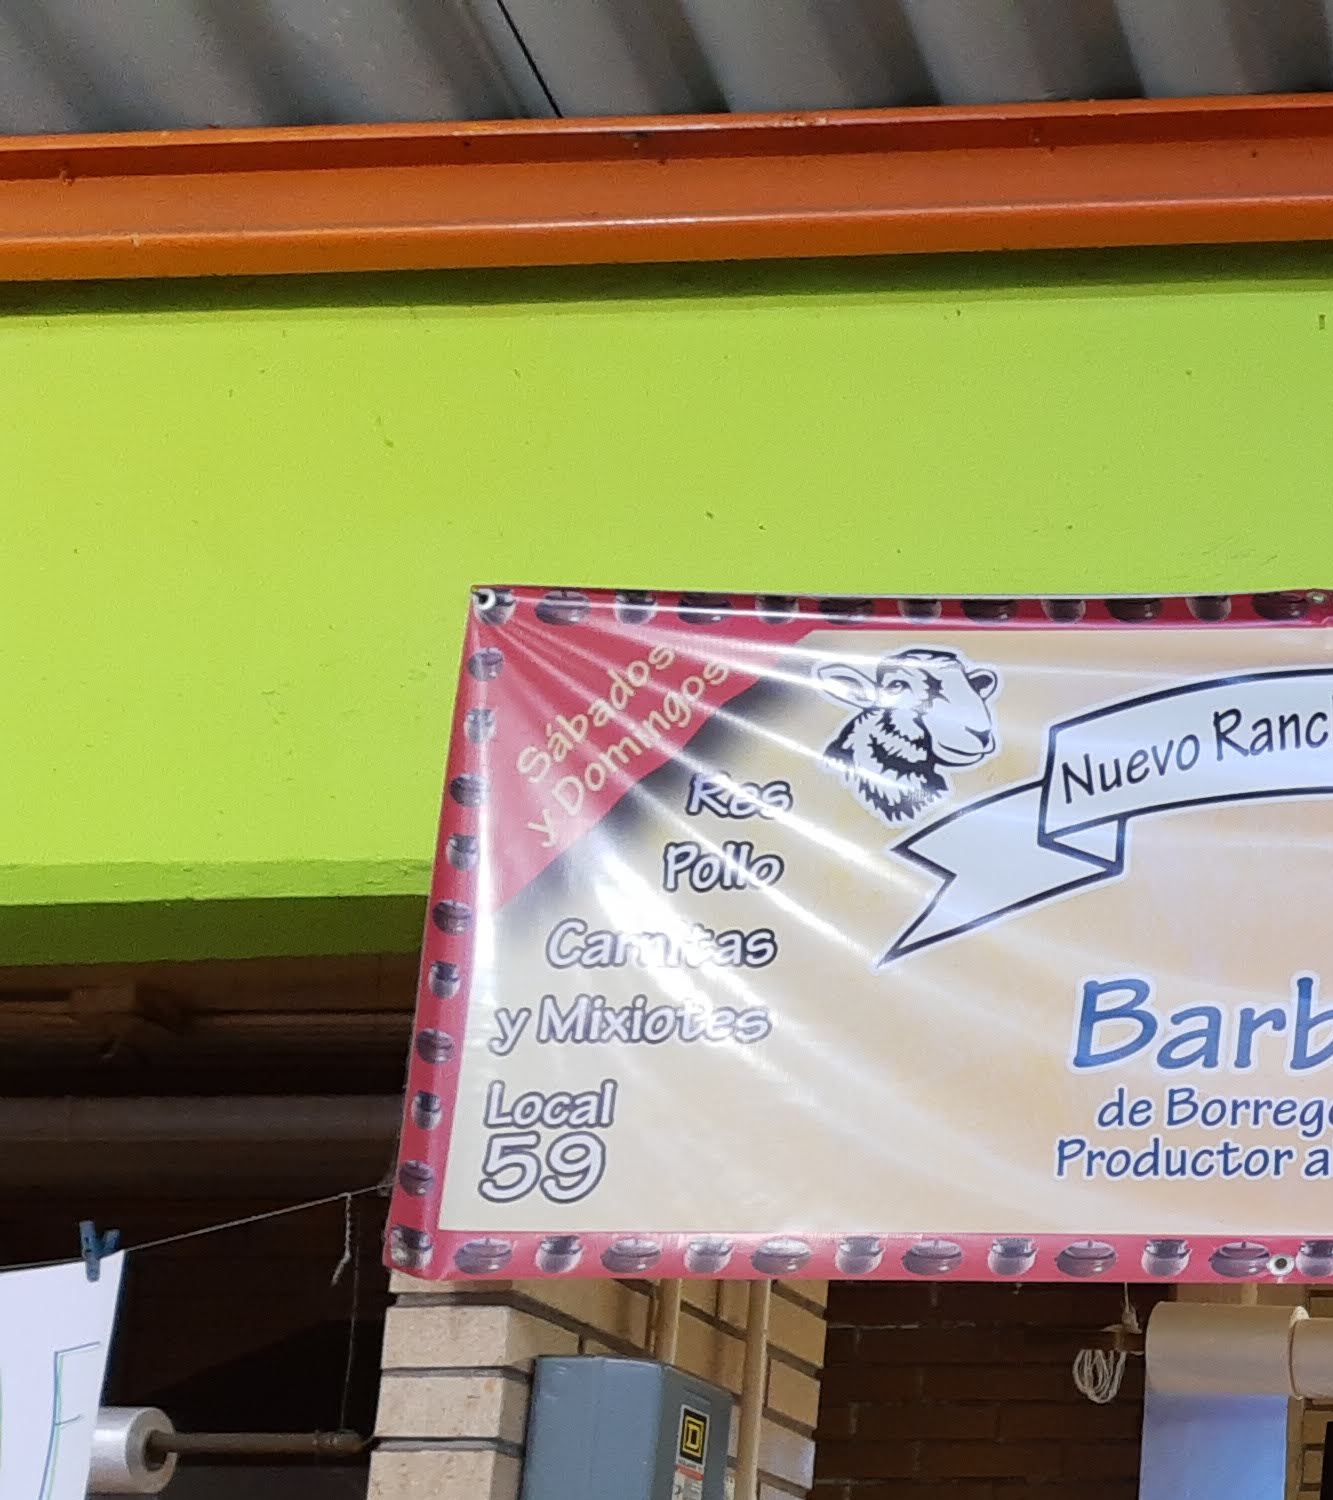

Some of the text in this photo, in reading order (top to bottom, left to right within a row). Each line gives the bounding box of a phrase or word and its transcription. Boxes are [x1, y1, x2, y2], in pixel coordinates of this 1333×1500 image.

[515, 642, 676, 785] Sábados
[526, 657, 731, 848] y Domingos
[1062, 732, 1201, 803] Nuevo
[687, 774, 792, 818] Res
[664, 842, 783, 892] Pollo
[491, 995, 771, 1054] y Mixiotes
[485, 1080, 616, 1128] Local
[1097, 1092, 1153, 1129] de
[478, 1132, 605, 1203] 59
[1056, 1138, 1297, 1181] Productor
